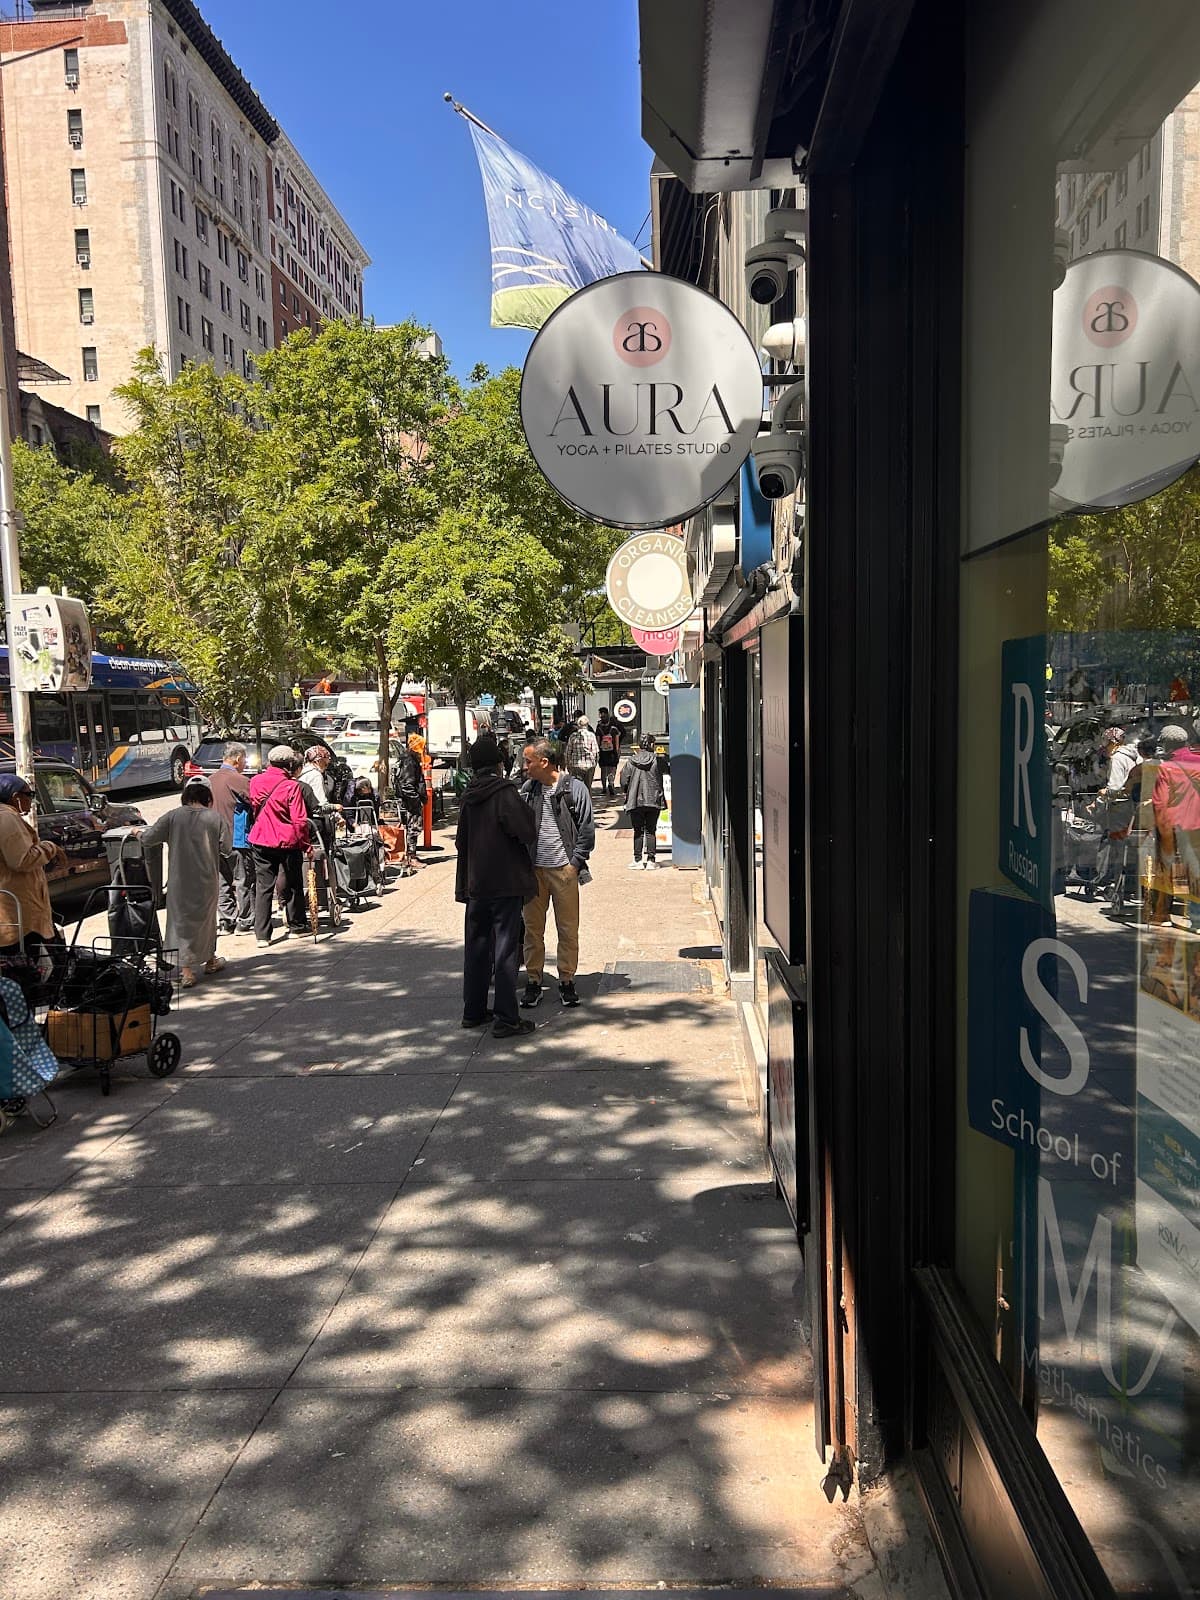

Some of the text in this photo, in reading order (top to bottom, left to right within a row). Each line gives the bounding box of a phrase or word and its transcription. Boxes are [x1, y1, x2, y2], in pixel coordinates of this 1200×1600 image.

[546, 382, 737, 437] AURA
[557, 444, 599, 456] YOGA
[615, 443, 673, 455] PILATES
[677, 442, 731, 454] STUDIO
[618, 538, 688, 568] ORGANIC
[619, 594, 692, 626] CLEANERS
[108, 656, 156, 675] clean-energy
[1012, 682, 1037, 838] R
[1008, 840, 1039, 888] Russian
[1019, 938, 1090, 1096] S
[991, 1098, 1079, 1167] School
[1090, 1151, 1122, 1185] of
[1019, 1335, 1168, 1491] Mathematics
